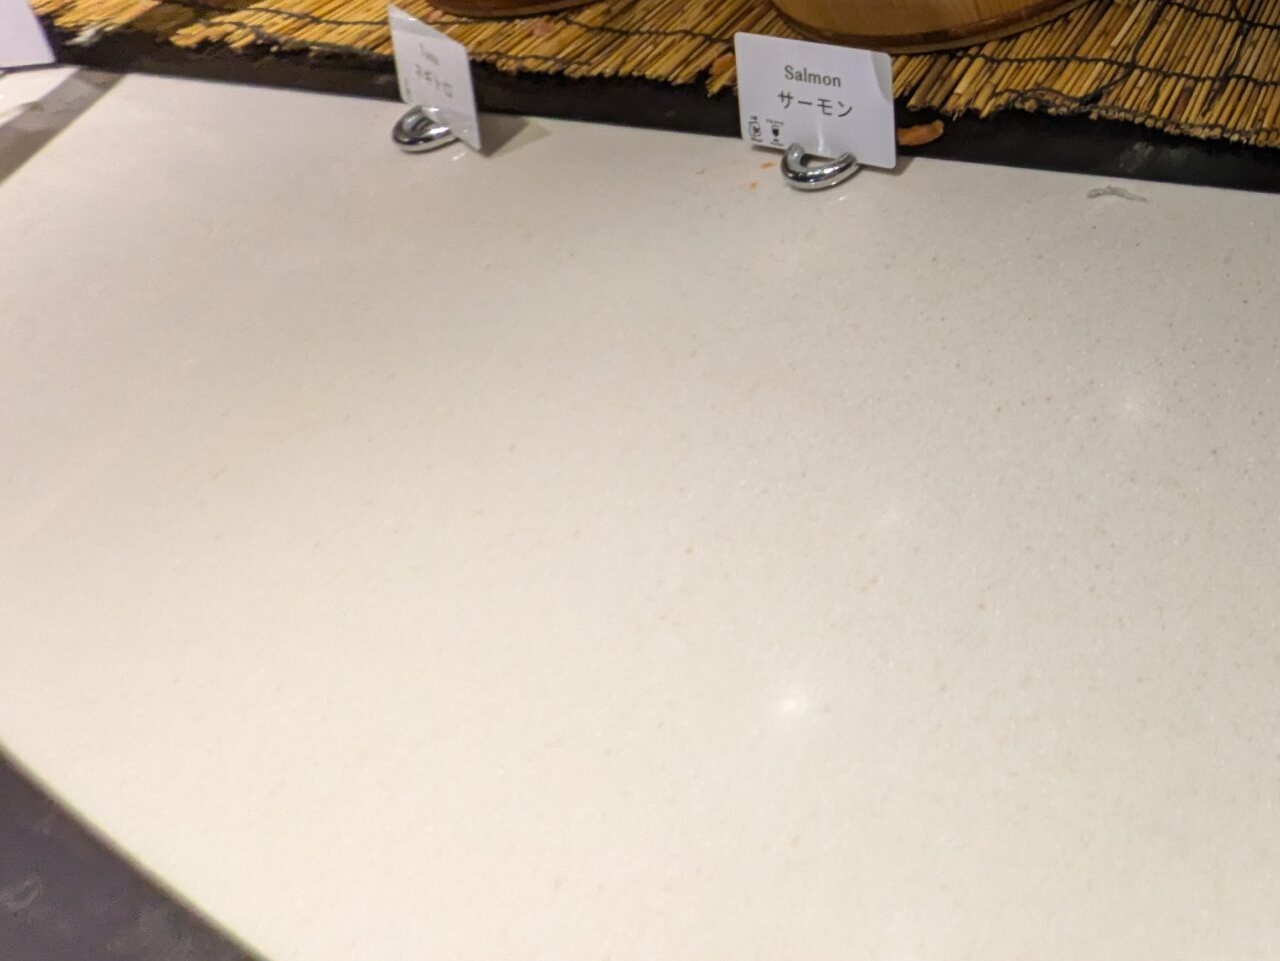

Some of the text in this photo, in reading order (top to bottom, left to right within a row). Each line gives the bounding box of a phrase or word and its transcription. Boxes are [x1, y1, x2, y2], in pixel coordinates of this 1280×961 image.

[784, 64, 842, 88] Salmon
[777, 90, 853, 118] サーモン
